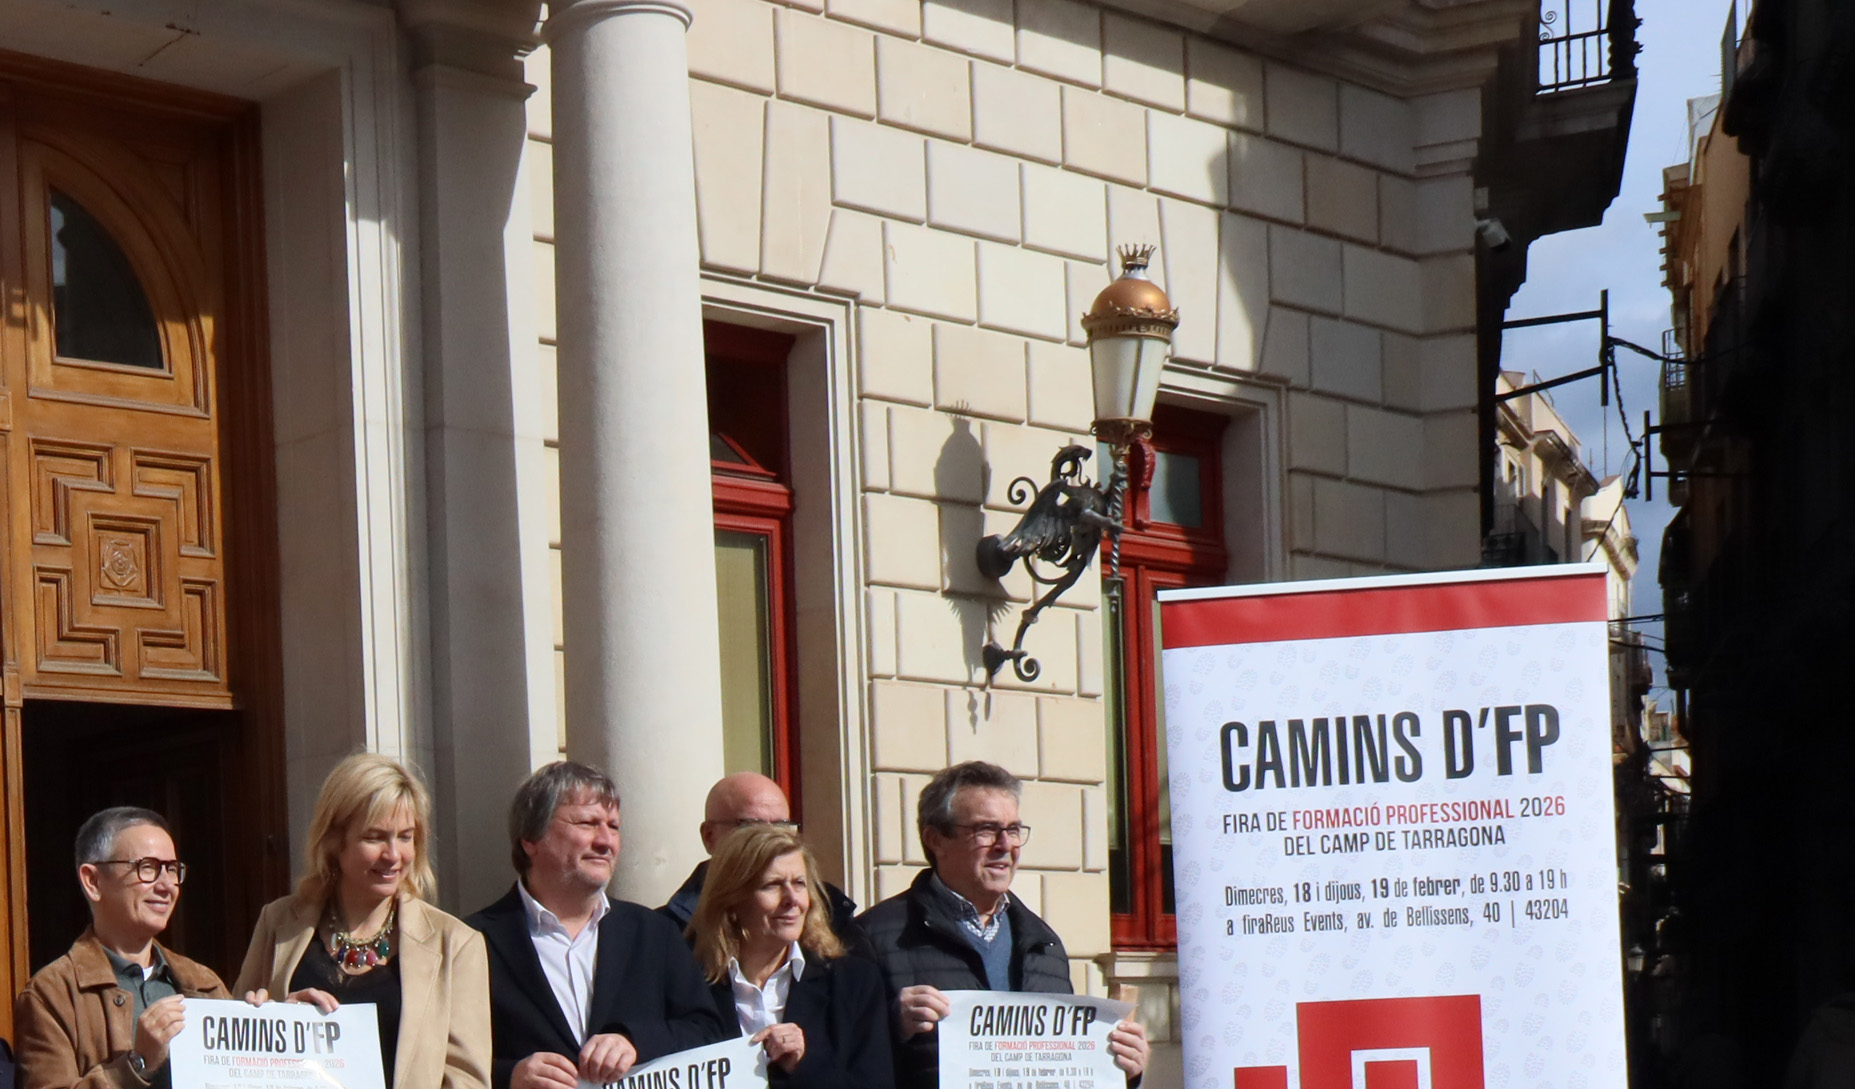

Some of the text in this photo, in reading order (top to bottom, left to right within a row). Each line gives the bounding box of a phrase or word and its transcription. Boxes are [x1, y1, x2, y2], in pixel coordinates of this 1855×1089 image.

[1220, 704, 1560, 792] CAMINS D'FP
[1223, 796, 1565, 834] FIRA DE FORMACIÓ PROFESSIONAL 2026
[1284, 825, 1505, 856] DEL CAMP DE TARRAGONA
[1225, 869, 1567, 907] Dimecres, 18 i dijous, 19 de febrer, de 9.30 a 19 h
[1227, 918, 1233, 936] a
[1243, 914, 1294, 935] firaReus
[1304, 911, 1348, 933] Events,
[1357, 912, 1374, 930] av.
[1384, 908, 1397, 928] de
[1407, 904, 1473, 928] Bellissens,
[1483, 903, 1500, 923] 40
[1526, 899, 1568, 920] 43204
[203, 1016, 341, 1054] CAMINS D'FP
[970, 1005, 1096, 1037] CAMINS D'FP
[204, 1055, 220, 1065] FIRA
[221, 1056, 231, 1065] DE
[969, 1041, 983, 1050] FIRA
[985, 1042, 993, 1050] DE
[991, 1053, 1003, 1062] DEL
[1005, 1053, 1023, 1061] CAMP
[1025, 1053, 1033, 1061] DE
[229, 1069, 241, 1078] DEL
